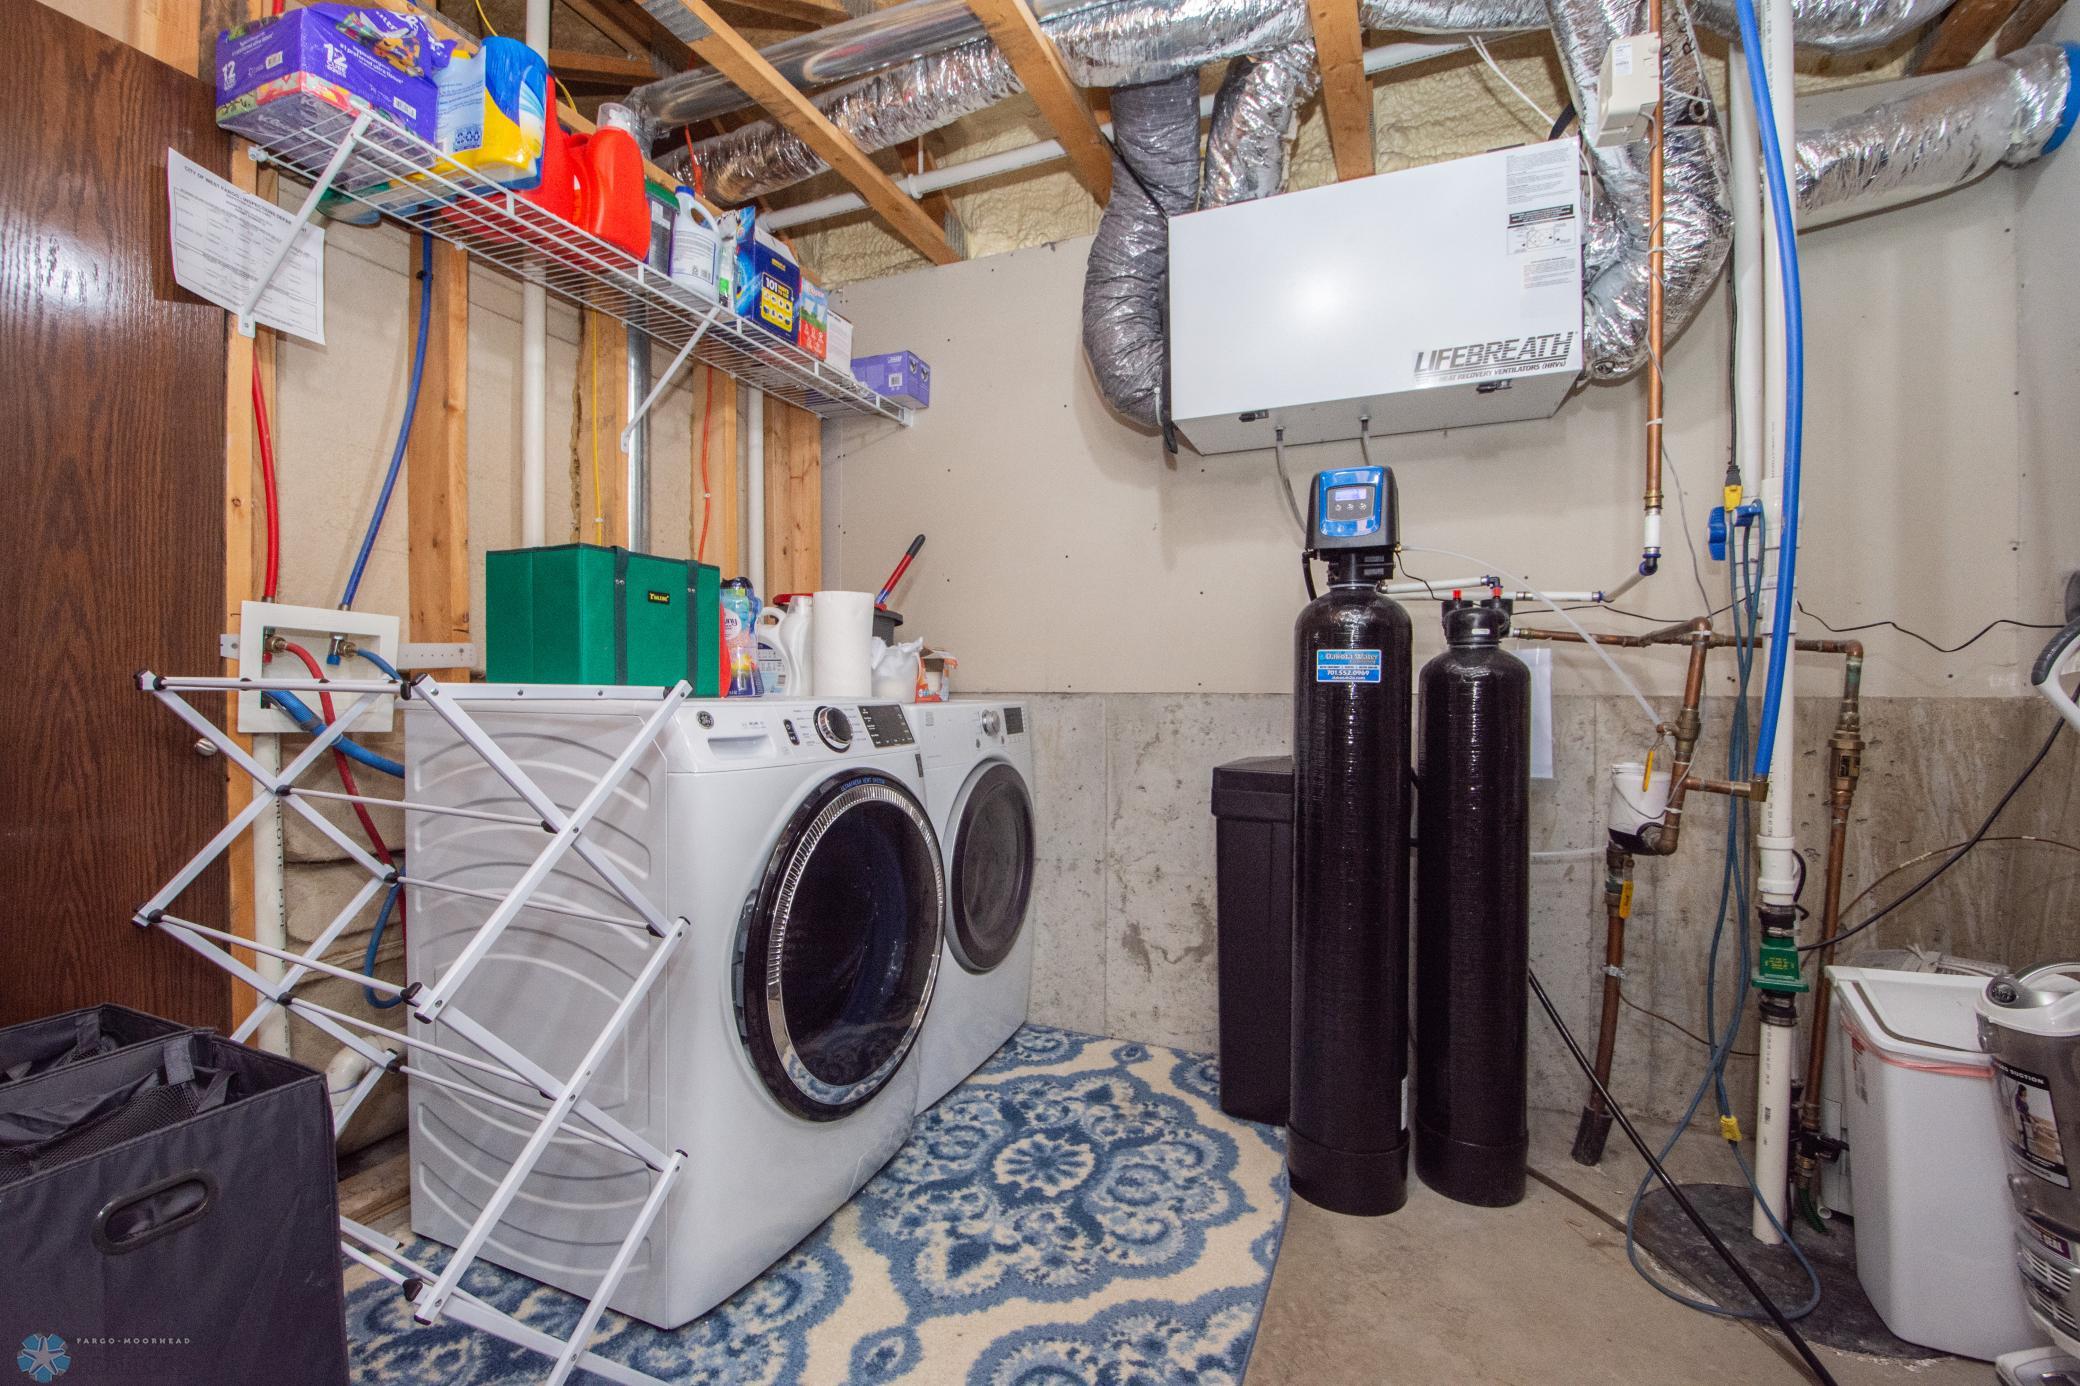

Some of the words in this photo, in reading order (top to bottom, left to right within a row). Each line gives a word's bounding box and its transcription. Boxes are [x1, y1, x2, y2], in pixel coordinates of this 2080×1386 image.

[323, 44, 347, 67] 12
[766, 278, 778, 292] 101
[1414, 331, 1573, 372] LIFEBREATH
[1457, 370, 1492, 380] RECOVERY
[1494, 364, 1540, 375] VENTILATORS
[2010, 1068, 2045, 1085] SUCTION
